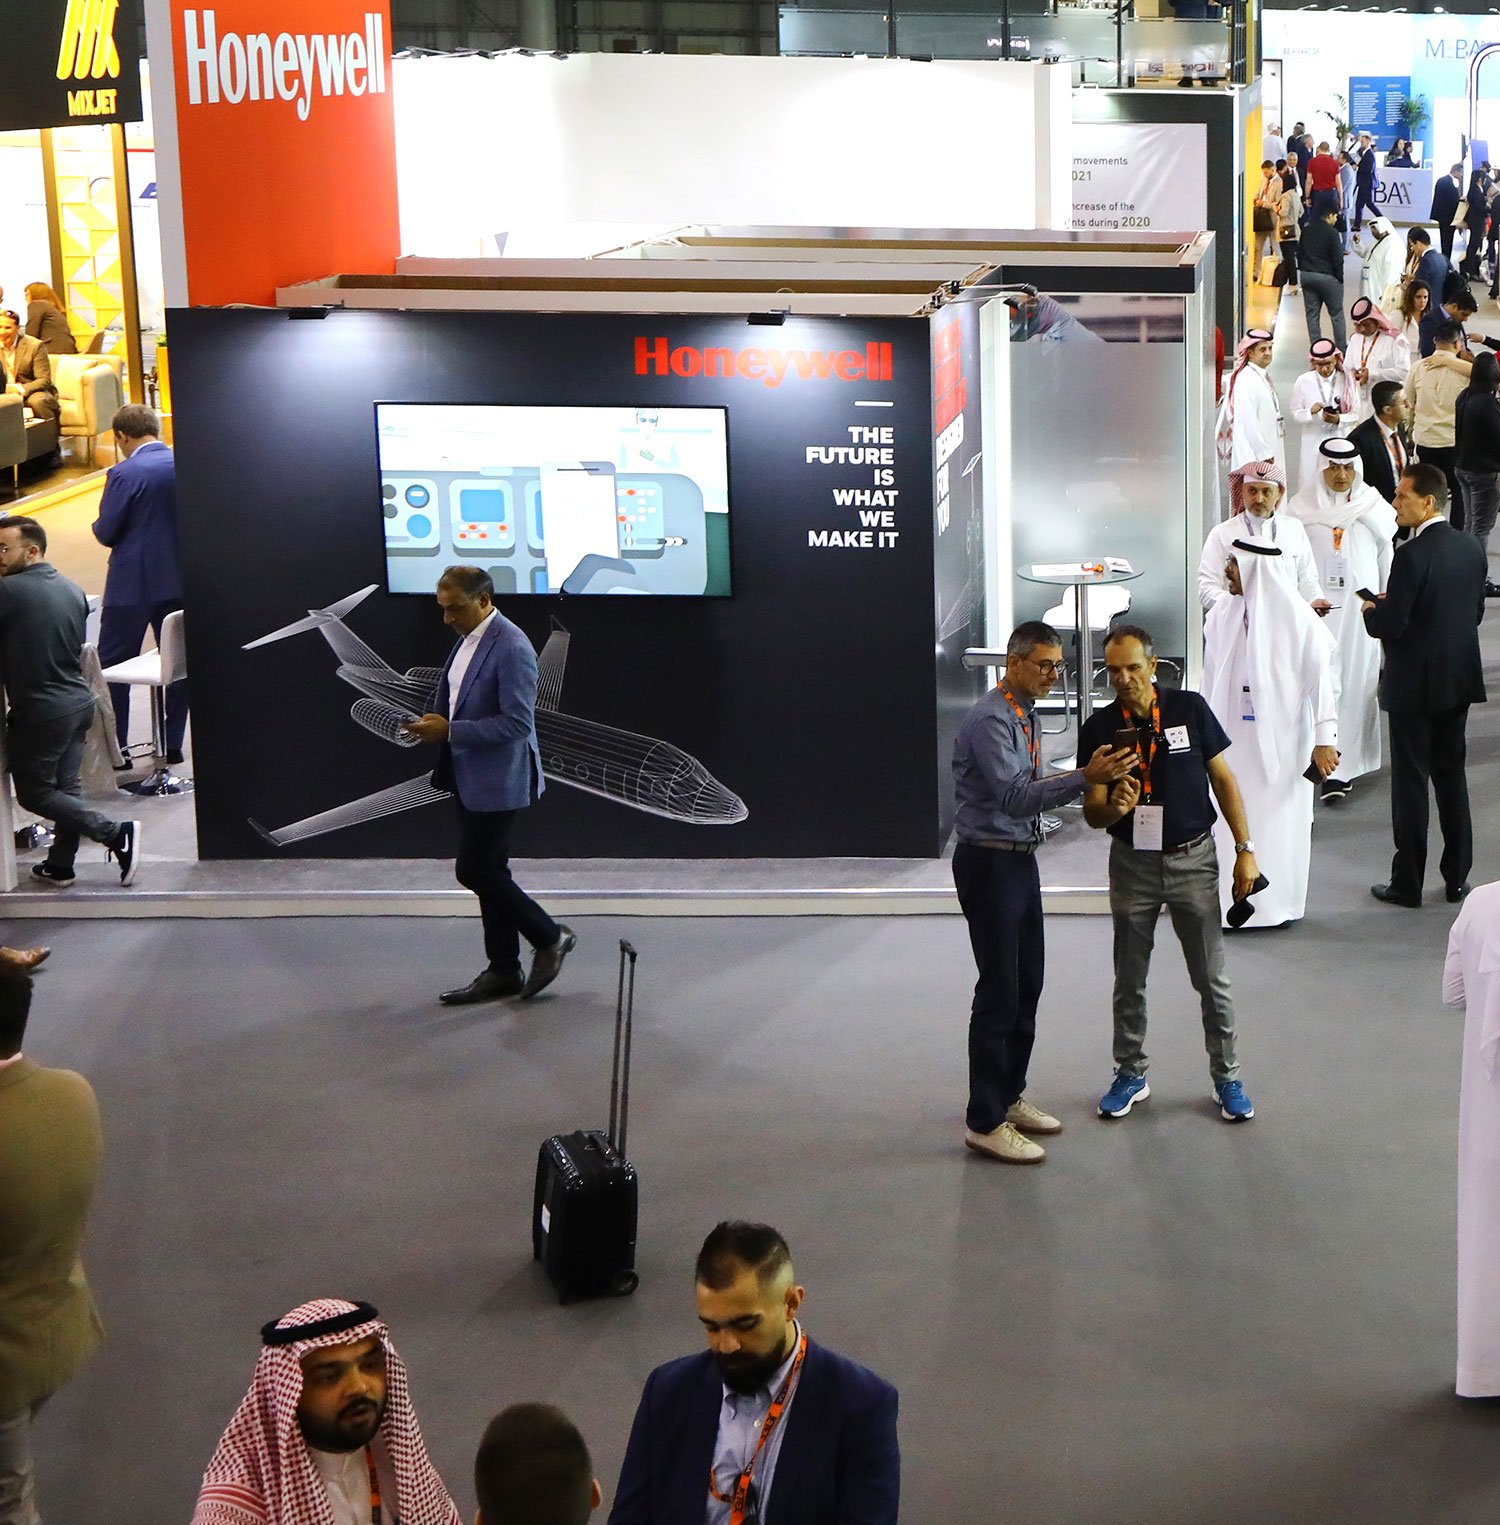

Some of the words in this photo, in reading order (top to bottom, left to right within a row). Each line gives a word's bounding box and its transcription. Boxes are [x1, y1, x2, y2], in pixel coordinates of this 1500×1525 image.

[184, 9, 386, 121] Honeywell
[67, 89, 118, 117] MIXJET
[1073, 157, 1128, 165] movements
[1109, 202, 1118, 210] of
[1120, 202, 1134, 210] the
[1089, 218, 1118, 229] during
[1122, 216, 1150, 227] 2020
[634, 336, 893, 388] Honeywell
[848, 426, 894, 444] THE
[806, 446, 894, 465] FUTURE
[874, 469, 894, 486] IS
[833, 489, 899, 506] WHAT
[859, 510, 894, 527] WE
[808, 530, 873, 548] MAKE
[878, 531, 899, 548] IT
